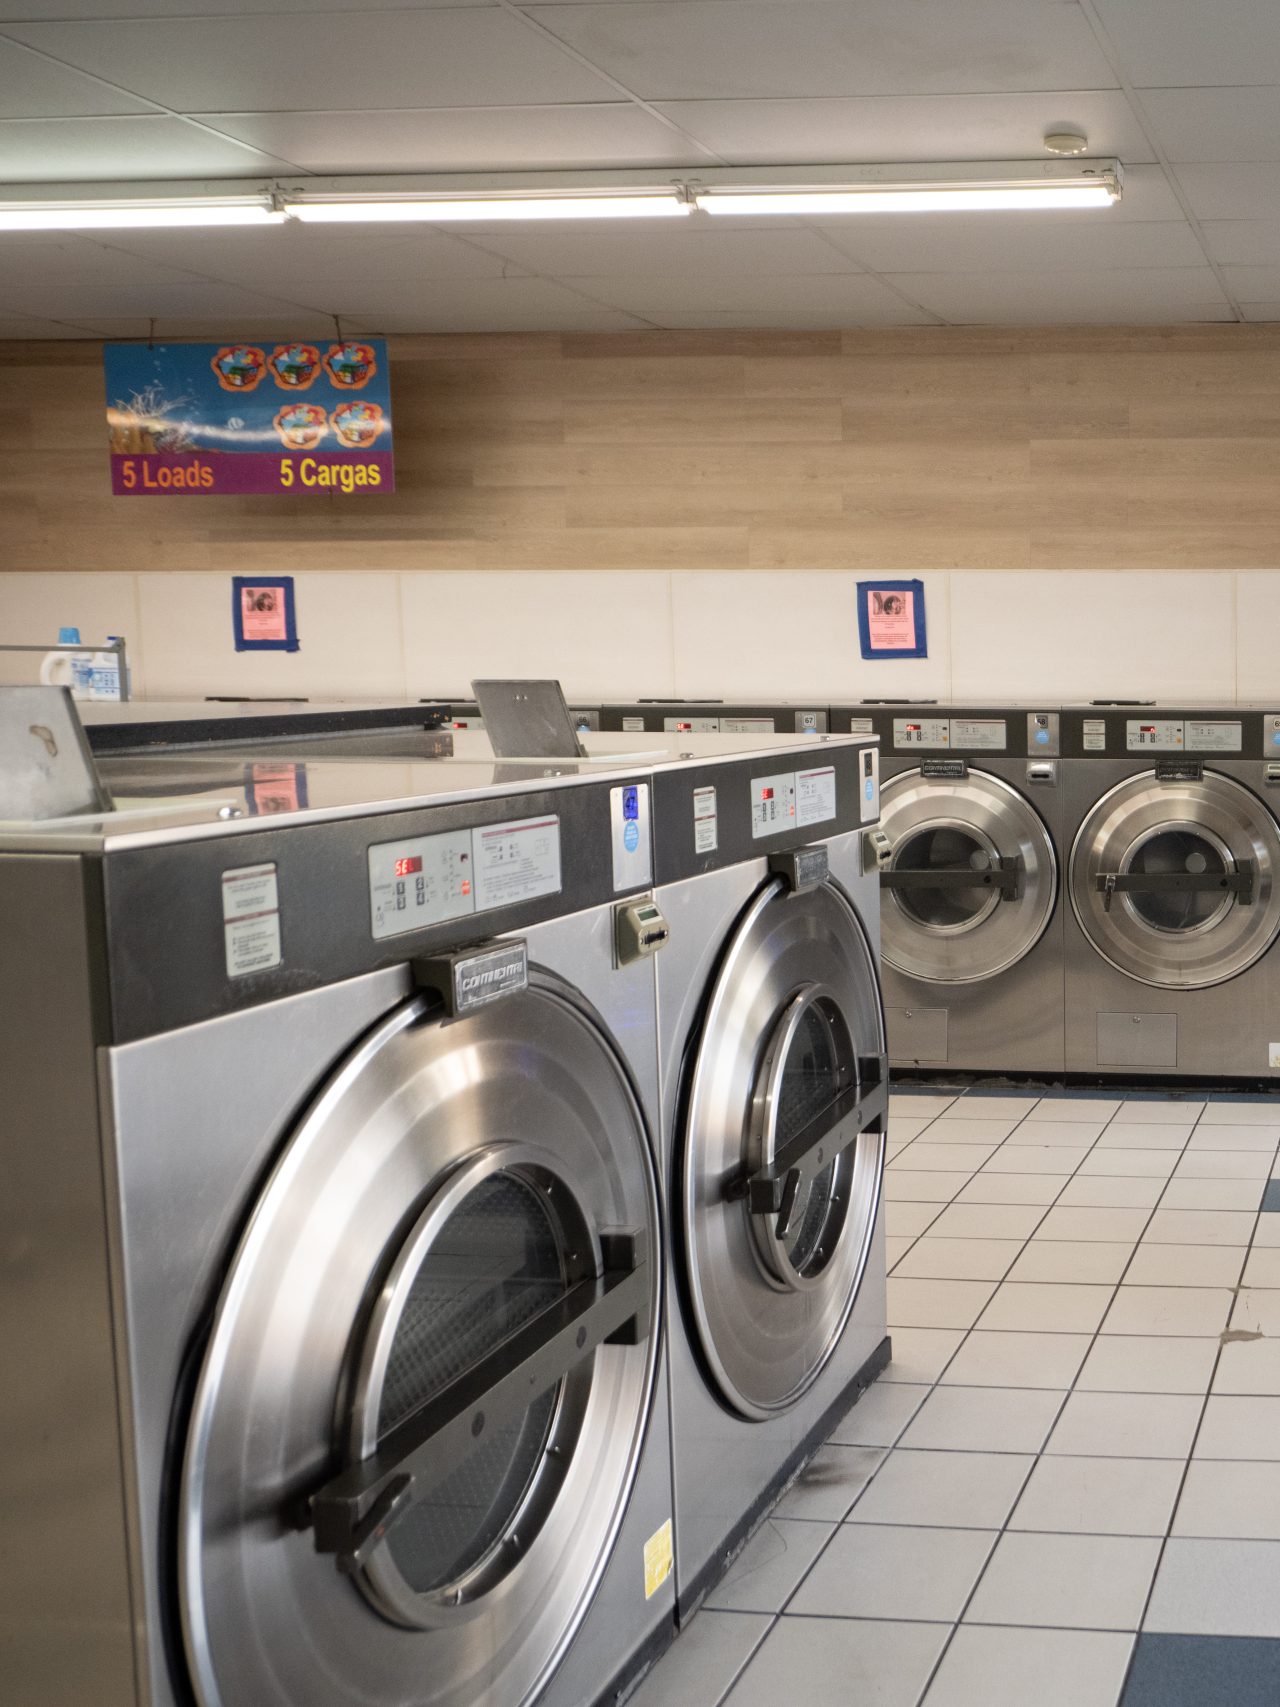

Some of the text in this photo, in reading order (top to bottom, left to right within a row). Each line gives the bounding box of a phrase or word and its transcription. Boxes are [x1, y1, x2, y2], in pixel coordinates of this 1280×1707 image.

[122, 460, 214, 489] 5 Loads
[280, 457, 382, 494] 5 Cargas
[803, 716, 815, 725] 67
